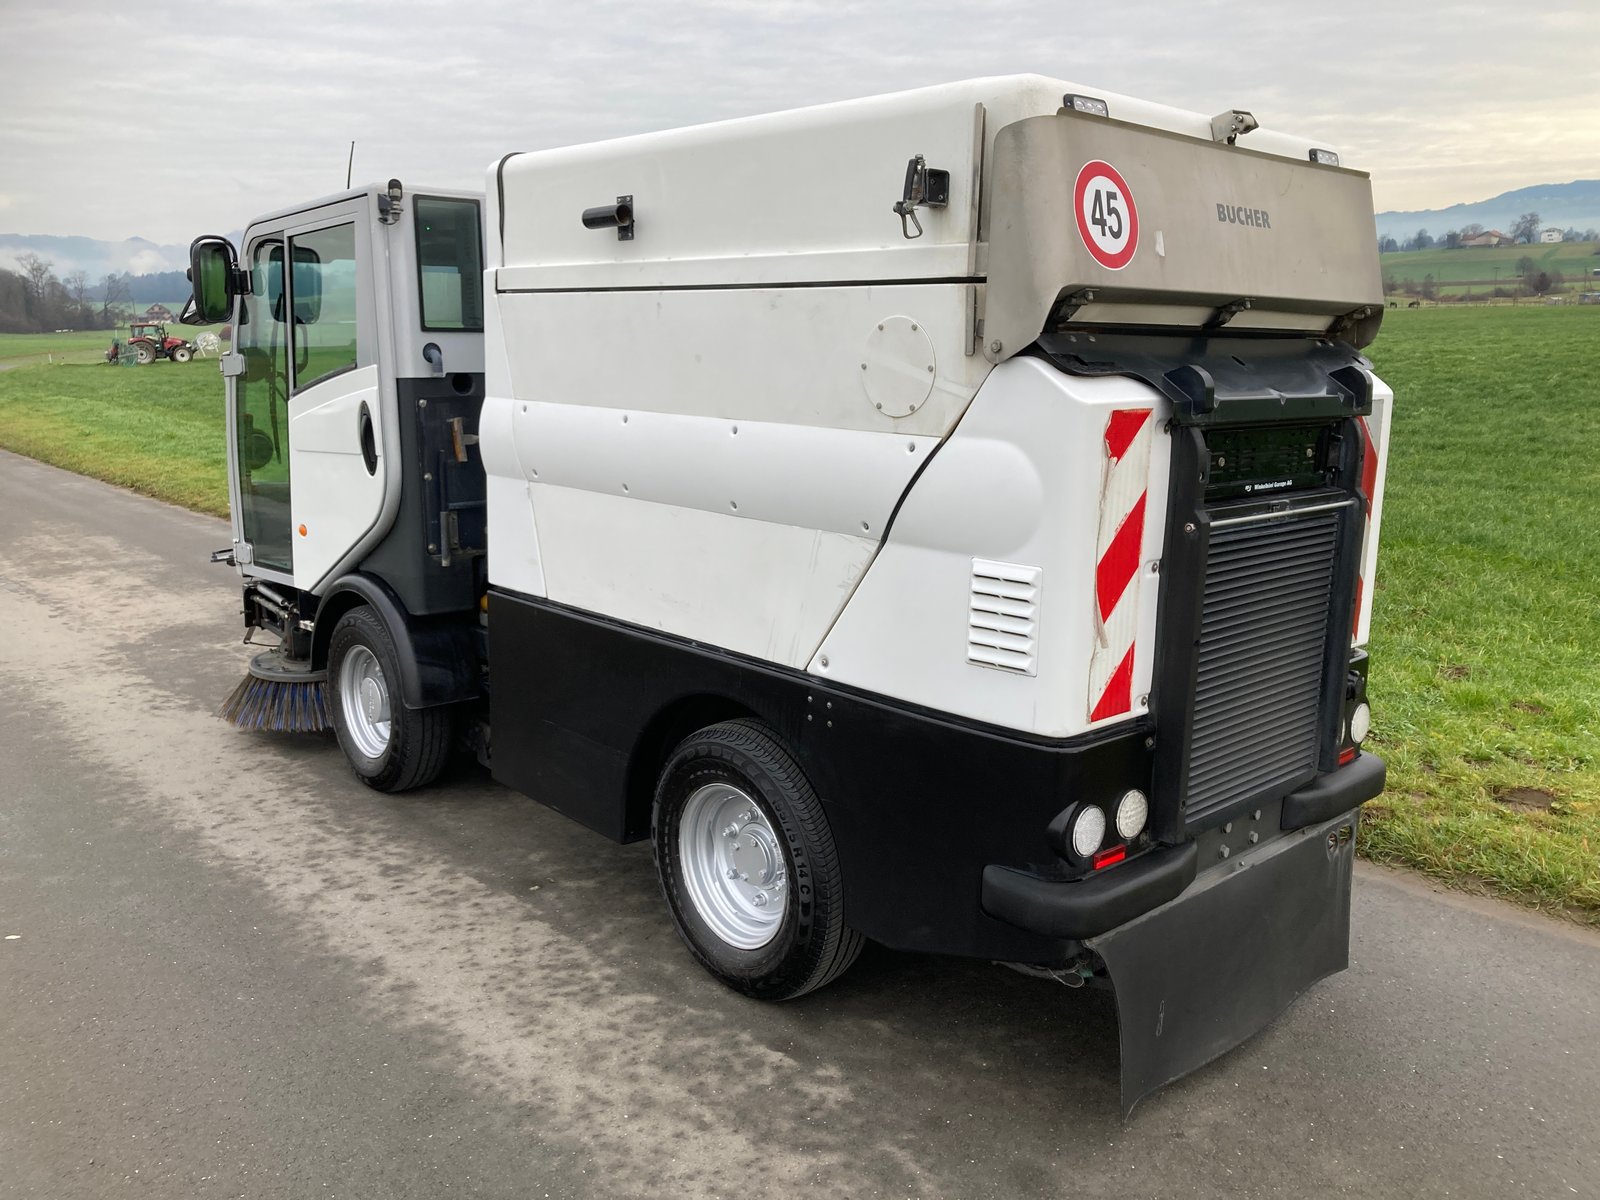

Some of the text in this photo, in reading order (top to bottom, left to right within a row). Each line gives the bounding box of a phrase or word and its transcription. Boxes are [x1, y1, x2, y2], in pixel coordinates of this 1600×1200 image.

[1091, 189, 1122, 240] 45
[1216, 203, 1271, 229] BUCHER
[797, 862, 809, 879] 14
[800, 884, 811, 895] C
